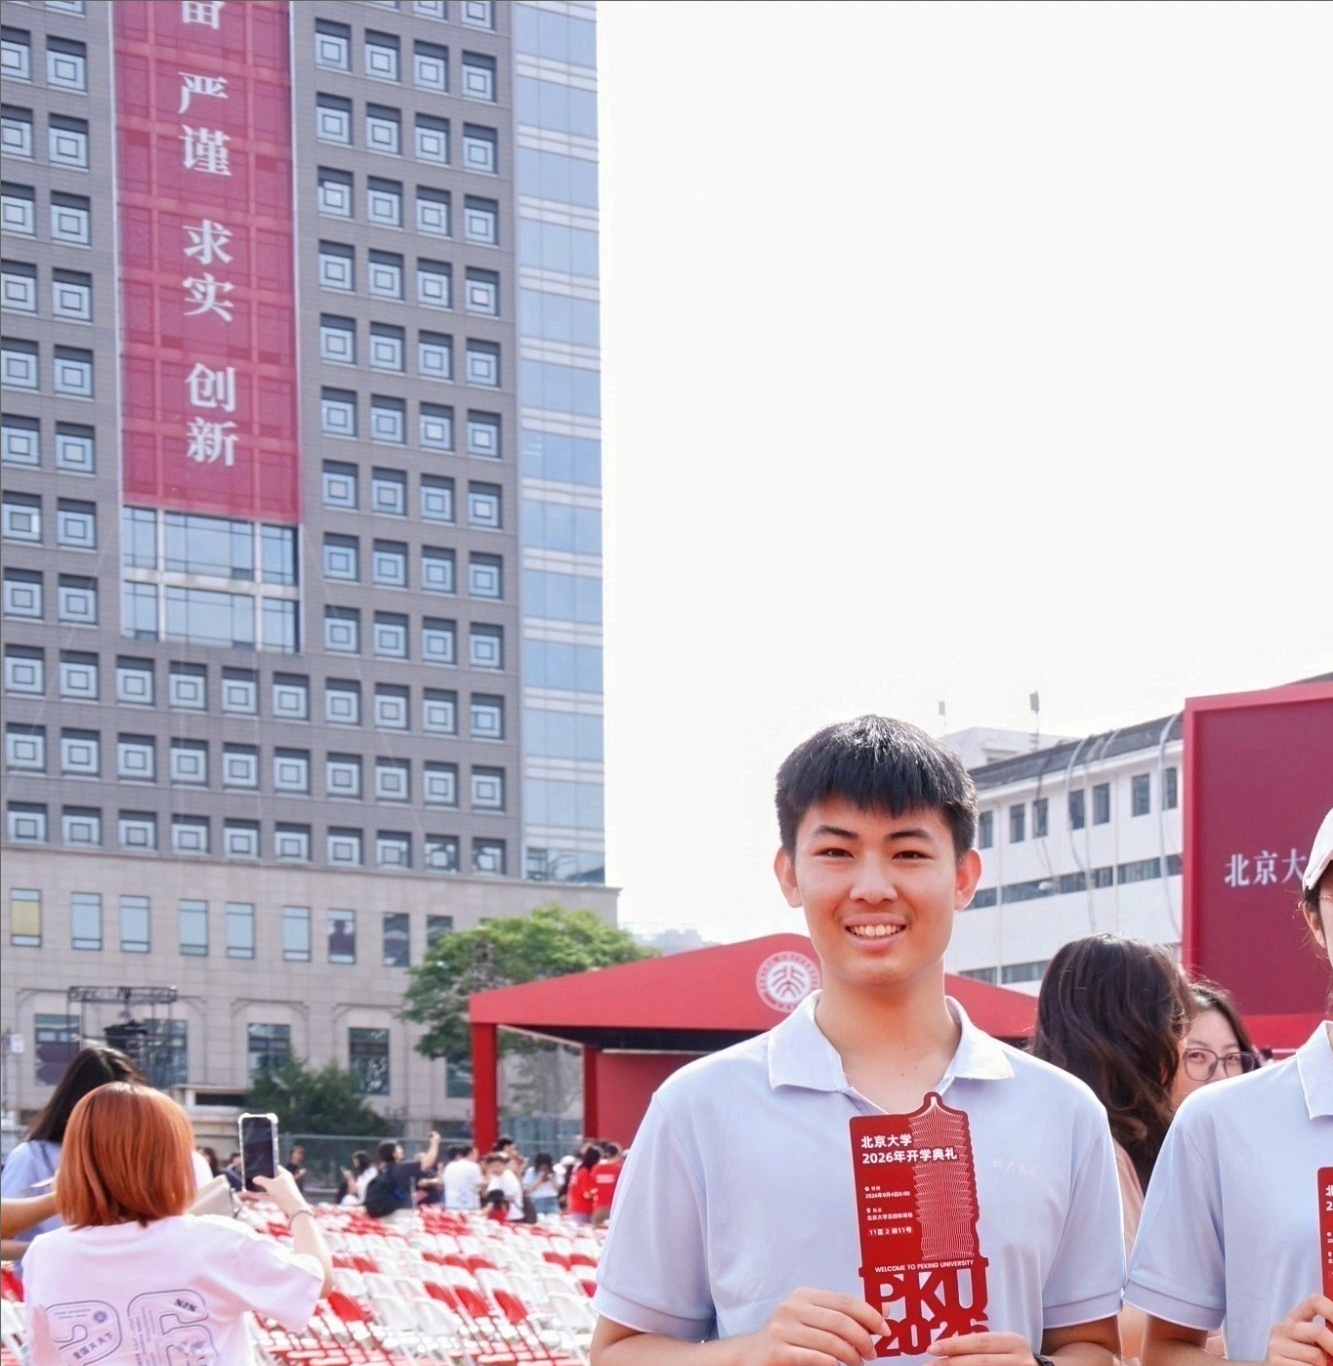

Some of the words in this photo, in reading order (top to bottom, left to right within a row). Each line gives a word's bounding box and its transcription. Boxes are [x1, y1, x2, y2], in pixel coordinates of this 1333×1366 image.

[178, 71, 233, 177] 严谨
[181, 219, 235, 322] 求实
[184, 362, 240, 467] 创新
[860, 1133, 912, 1149] 北京大学
[862, 1146, 957, 1164] 2026年开学典礼
[874, 1264, 906, 1273] WELCOME
[916, 1261, 939, 1269] PEKING
[939, 1259, 974, 1268] UNIVERSITY
